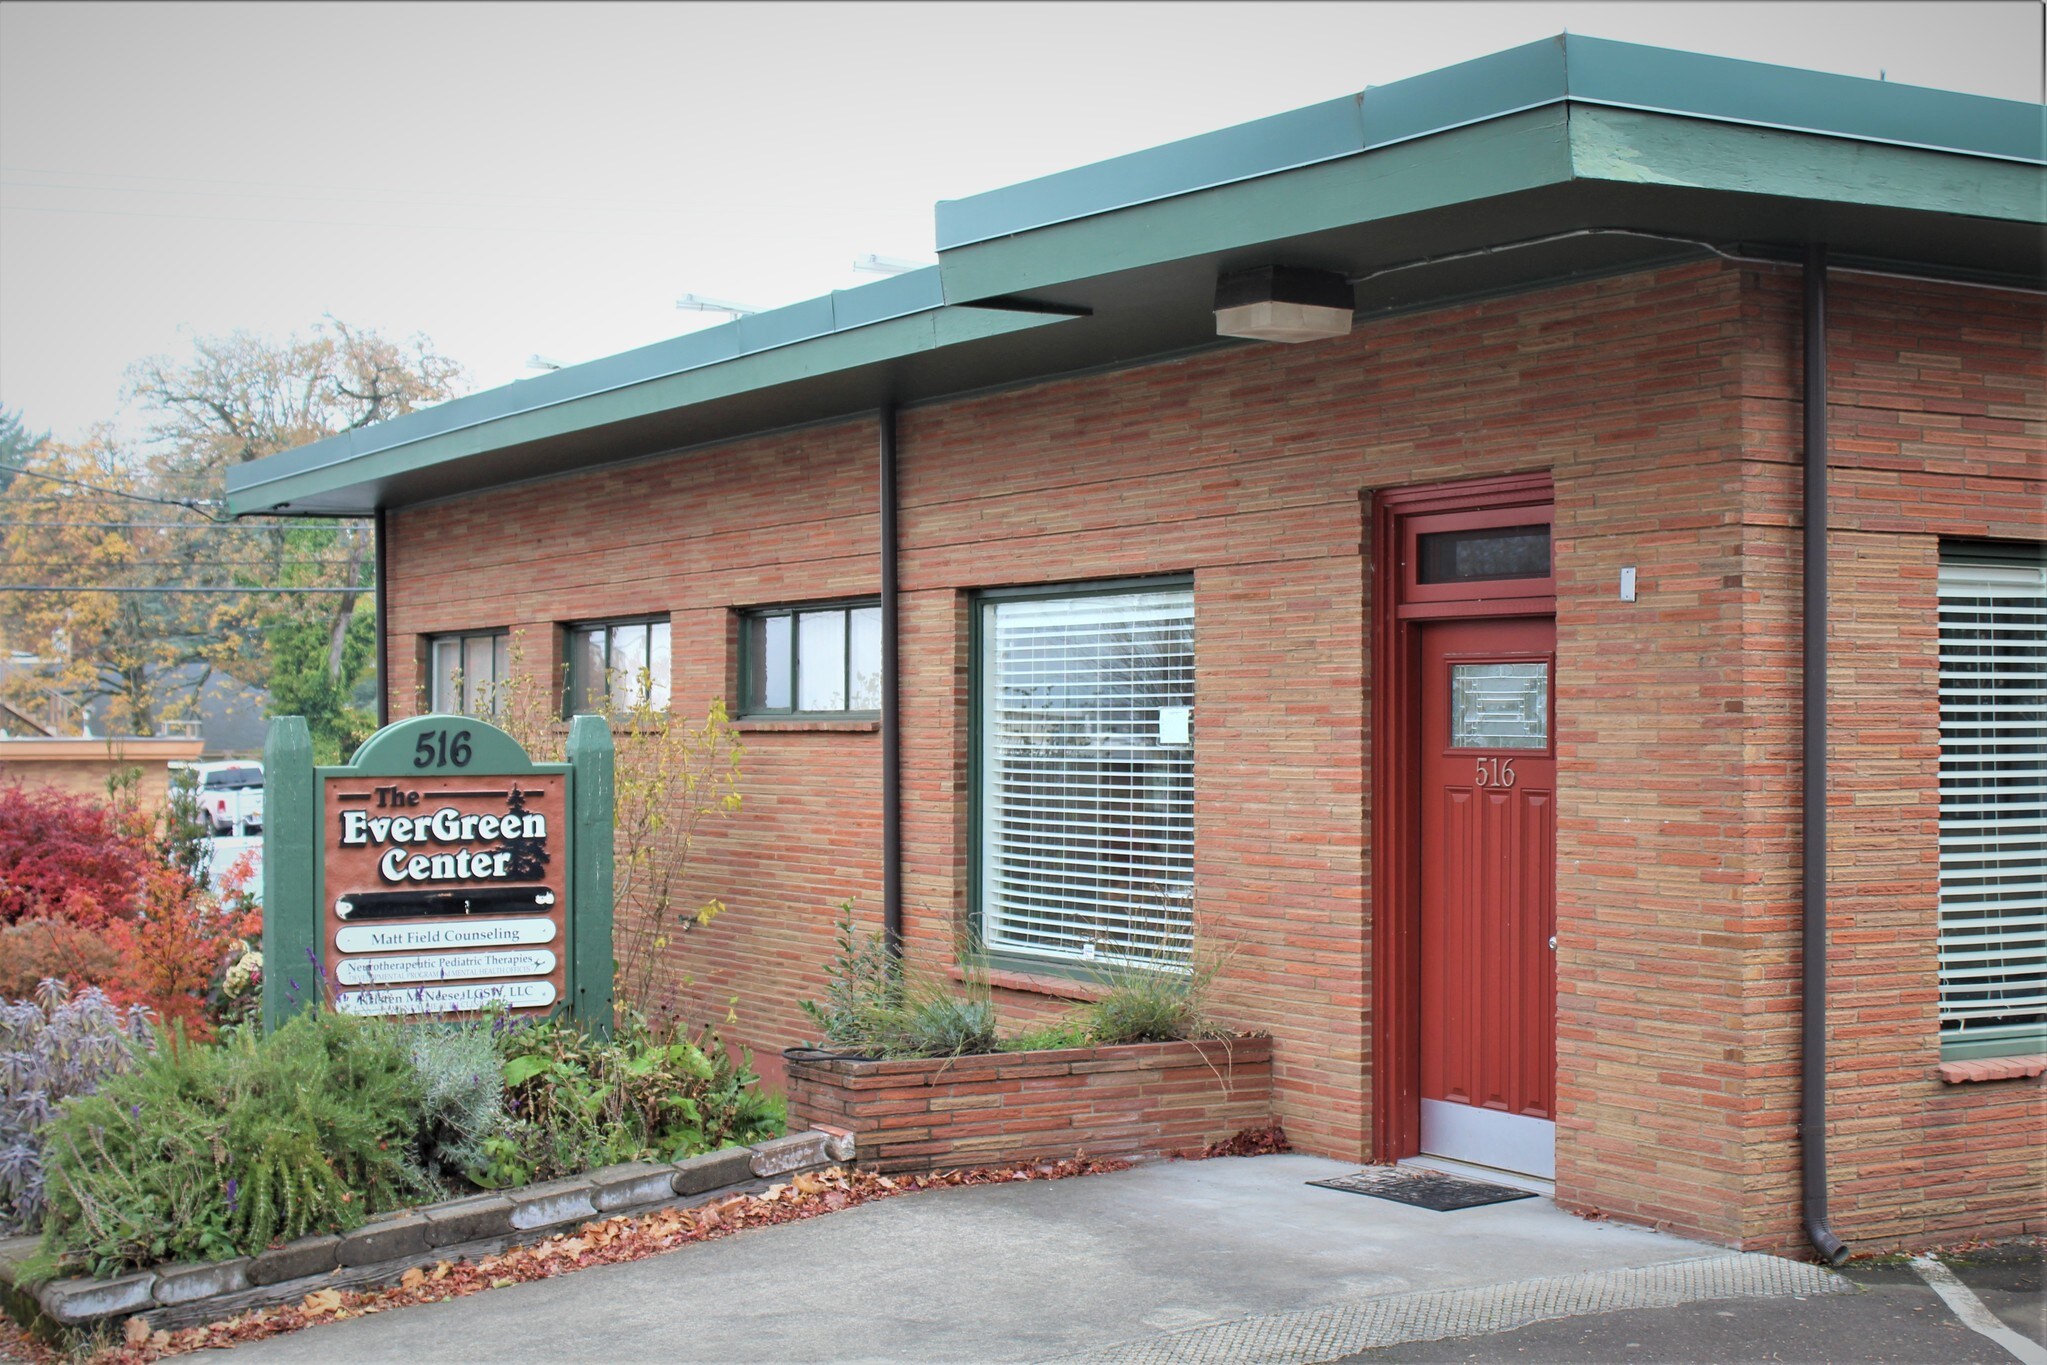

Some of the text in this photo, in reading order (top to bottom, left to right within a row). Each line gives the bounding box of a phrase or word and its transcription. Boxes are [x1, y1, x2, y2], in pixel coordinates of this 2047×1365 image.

[413, 730, 472, 769] 516
[1475, 757, 1516, 787] 516
[374, 784, 420, 808] The
[342, 807, 547, 845] EverGreen
[380, 847, 511, 882] Center
[371, 927, 520, 945] Matt Field Counseling
[439, 955, 482, 968] Pediatric
[485, 953, 532, 967] Therapies
[349, 972, 404, 982] DEVELPMENTAL
[360, 991, 402, 1005] Ksten
[406, 990, 465, 1003] MNeese,
[510, 985, 533, 997] LLC
